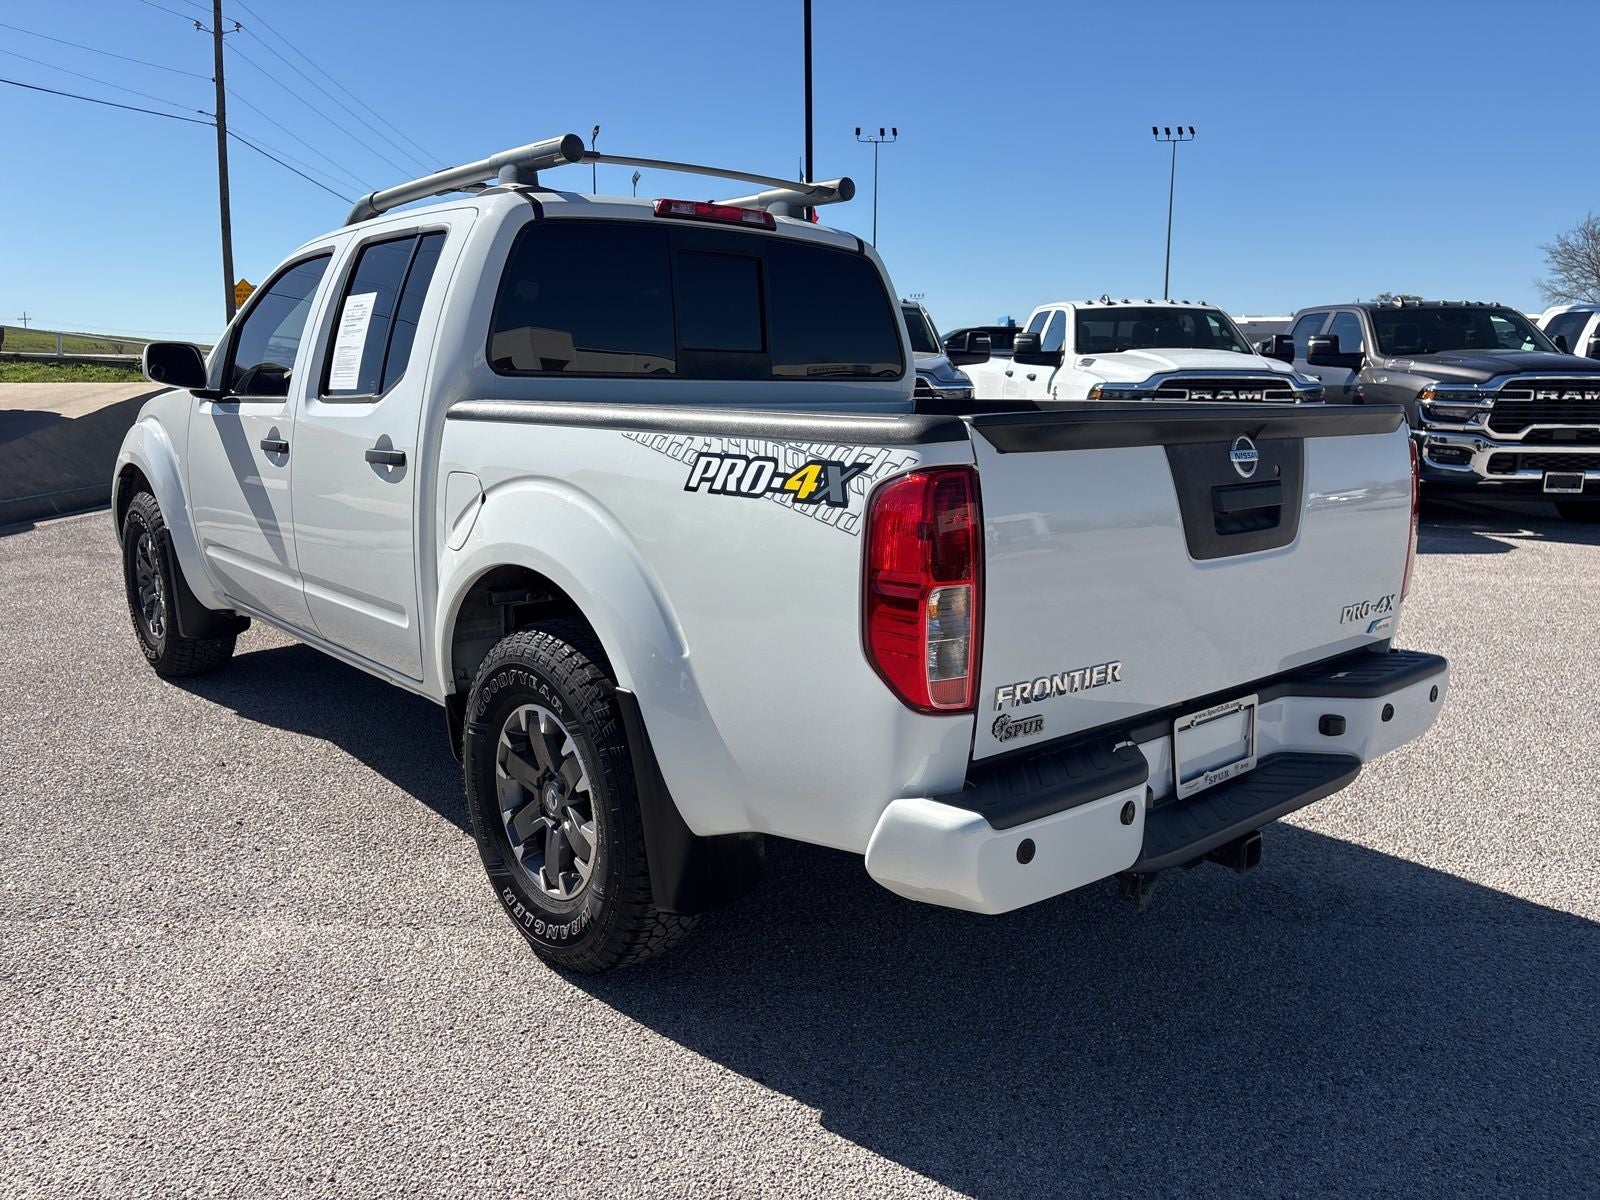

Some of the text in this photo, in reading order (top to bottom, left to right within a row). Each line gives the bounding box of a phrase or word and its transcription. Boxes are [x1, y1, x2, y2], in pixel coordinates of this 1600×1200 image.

[1191, 390, 1262, 400] RAM
[1536, 390, 1600, 400] RAM
[684, 453, 872, 508] PRO-4X
[1340, 594, 1396, 624] PRO-4X
[476, 669, 564, 716] GOODYEAR
[993, 660, 1122, 711] FRONTIER
[1004, 719, 1044, 740] SPUR
[1208, 770, 1230, 785] SPUR
[502, 887, 592, 940] WRANGLER
